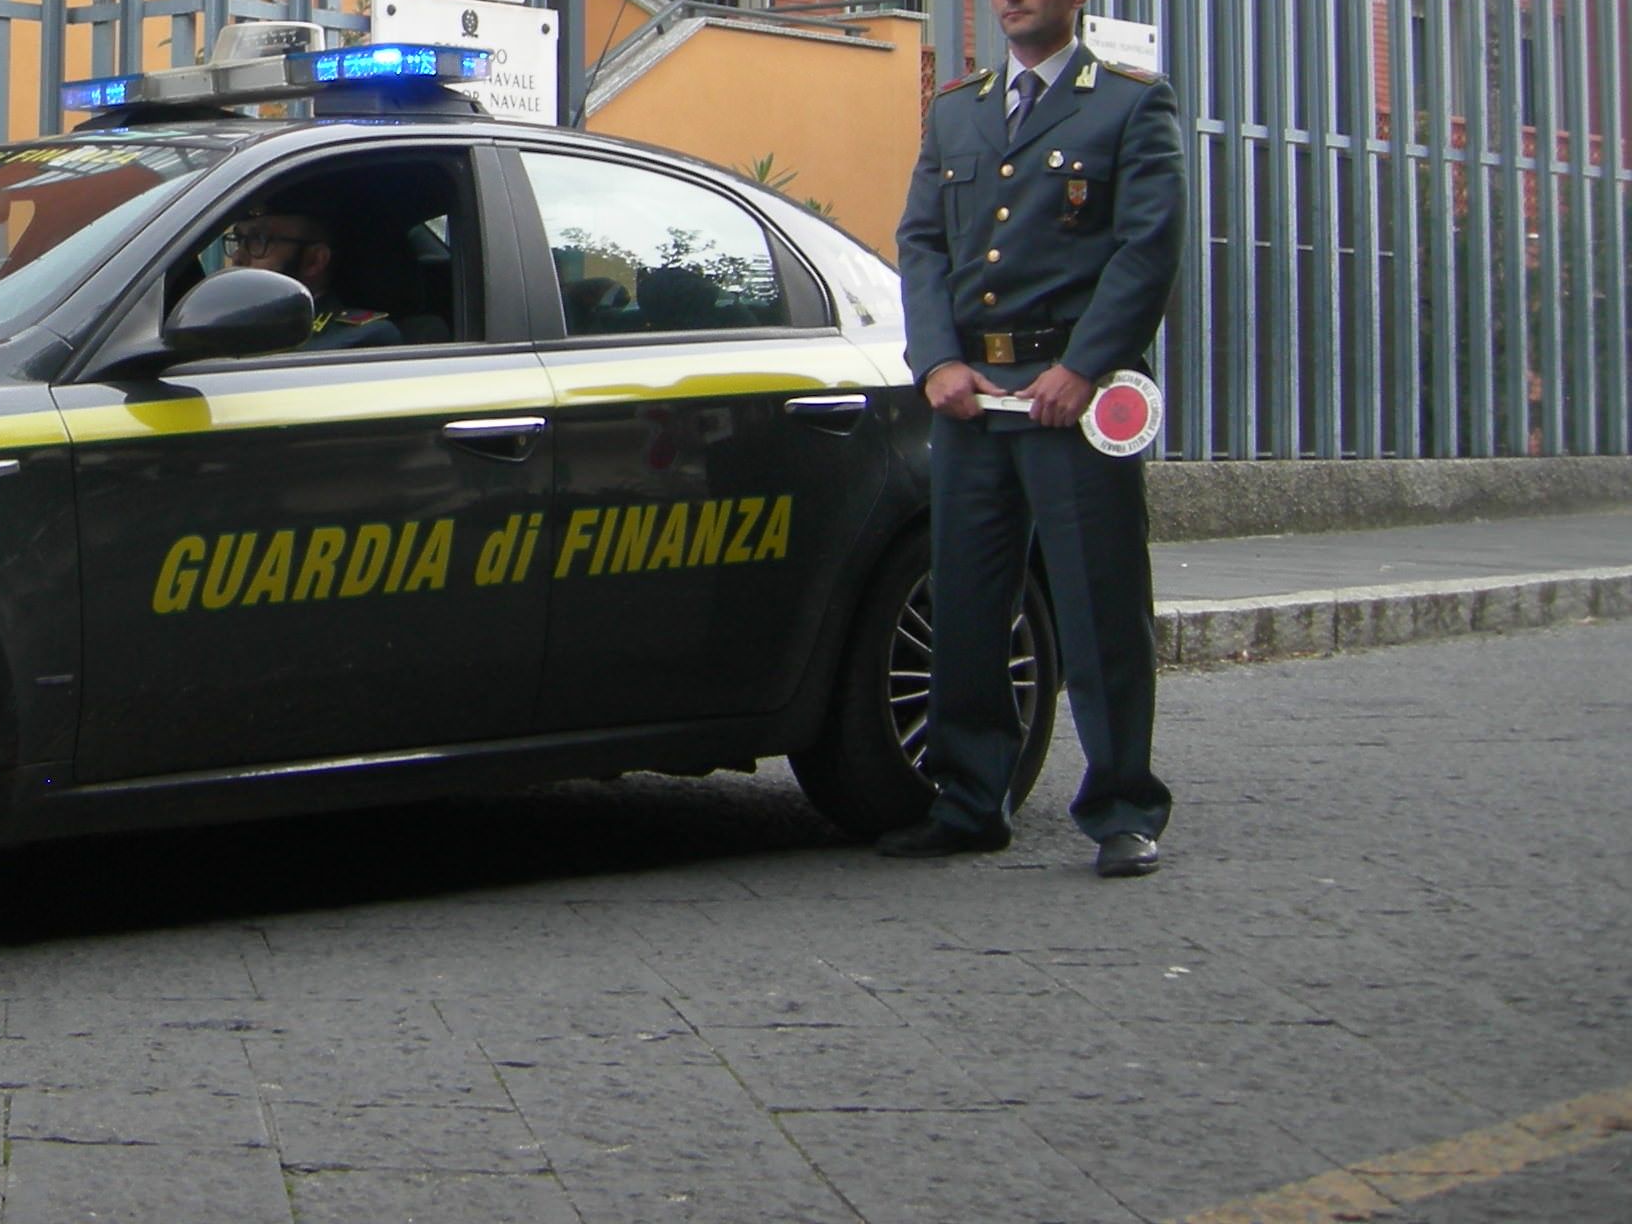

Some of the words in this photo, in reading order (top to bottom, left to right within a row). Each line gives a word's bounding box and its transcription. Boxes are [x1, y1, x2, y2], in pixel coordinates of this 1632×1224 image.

[490, 92, 542, 113] NAVALE
[153, 519, 454, 615] GUARDIA
[475, 513, 543, 586] di
[554, 495, 794, 579] FINANZA
